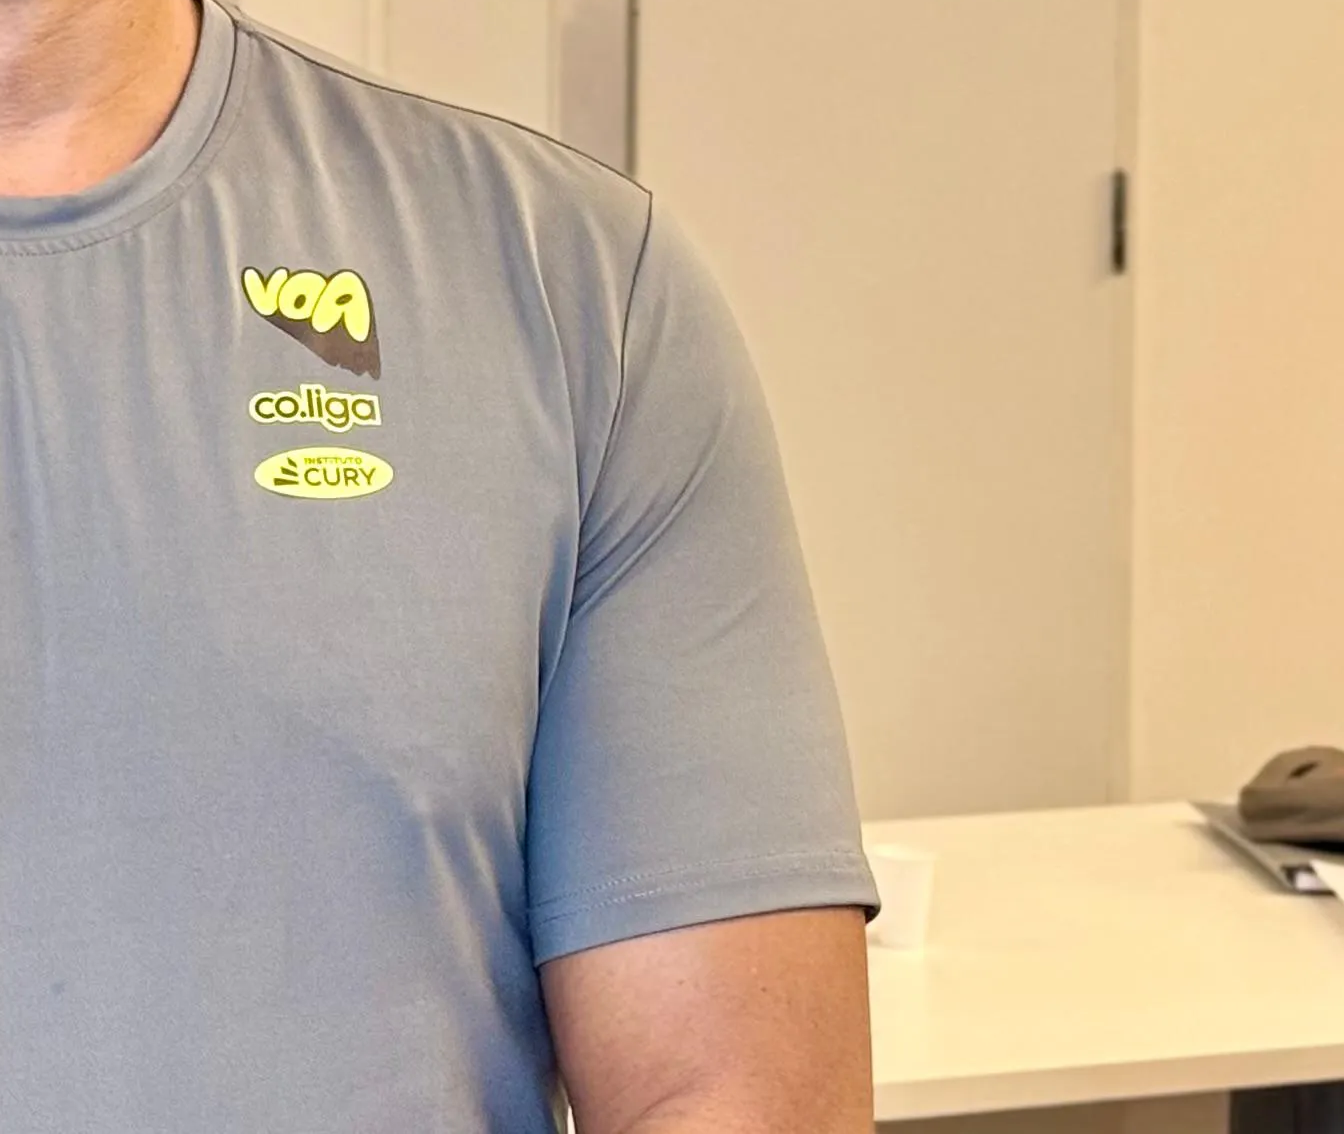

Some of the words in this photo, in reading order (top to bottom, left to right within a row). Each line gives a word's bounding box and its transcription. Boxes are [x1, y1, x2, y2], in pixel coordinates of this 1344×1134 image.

[241, 266, 375, 342] VOA
[255, 388, 375, 428] co.liga
[304, 457, 362, 465] INSTITUTO
[304, 467, 376, 487] CURY
